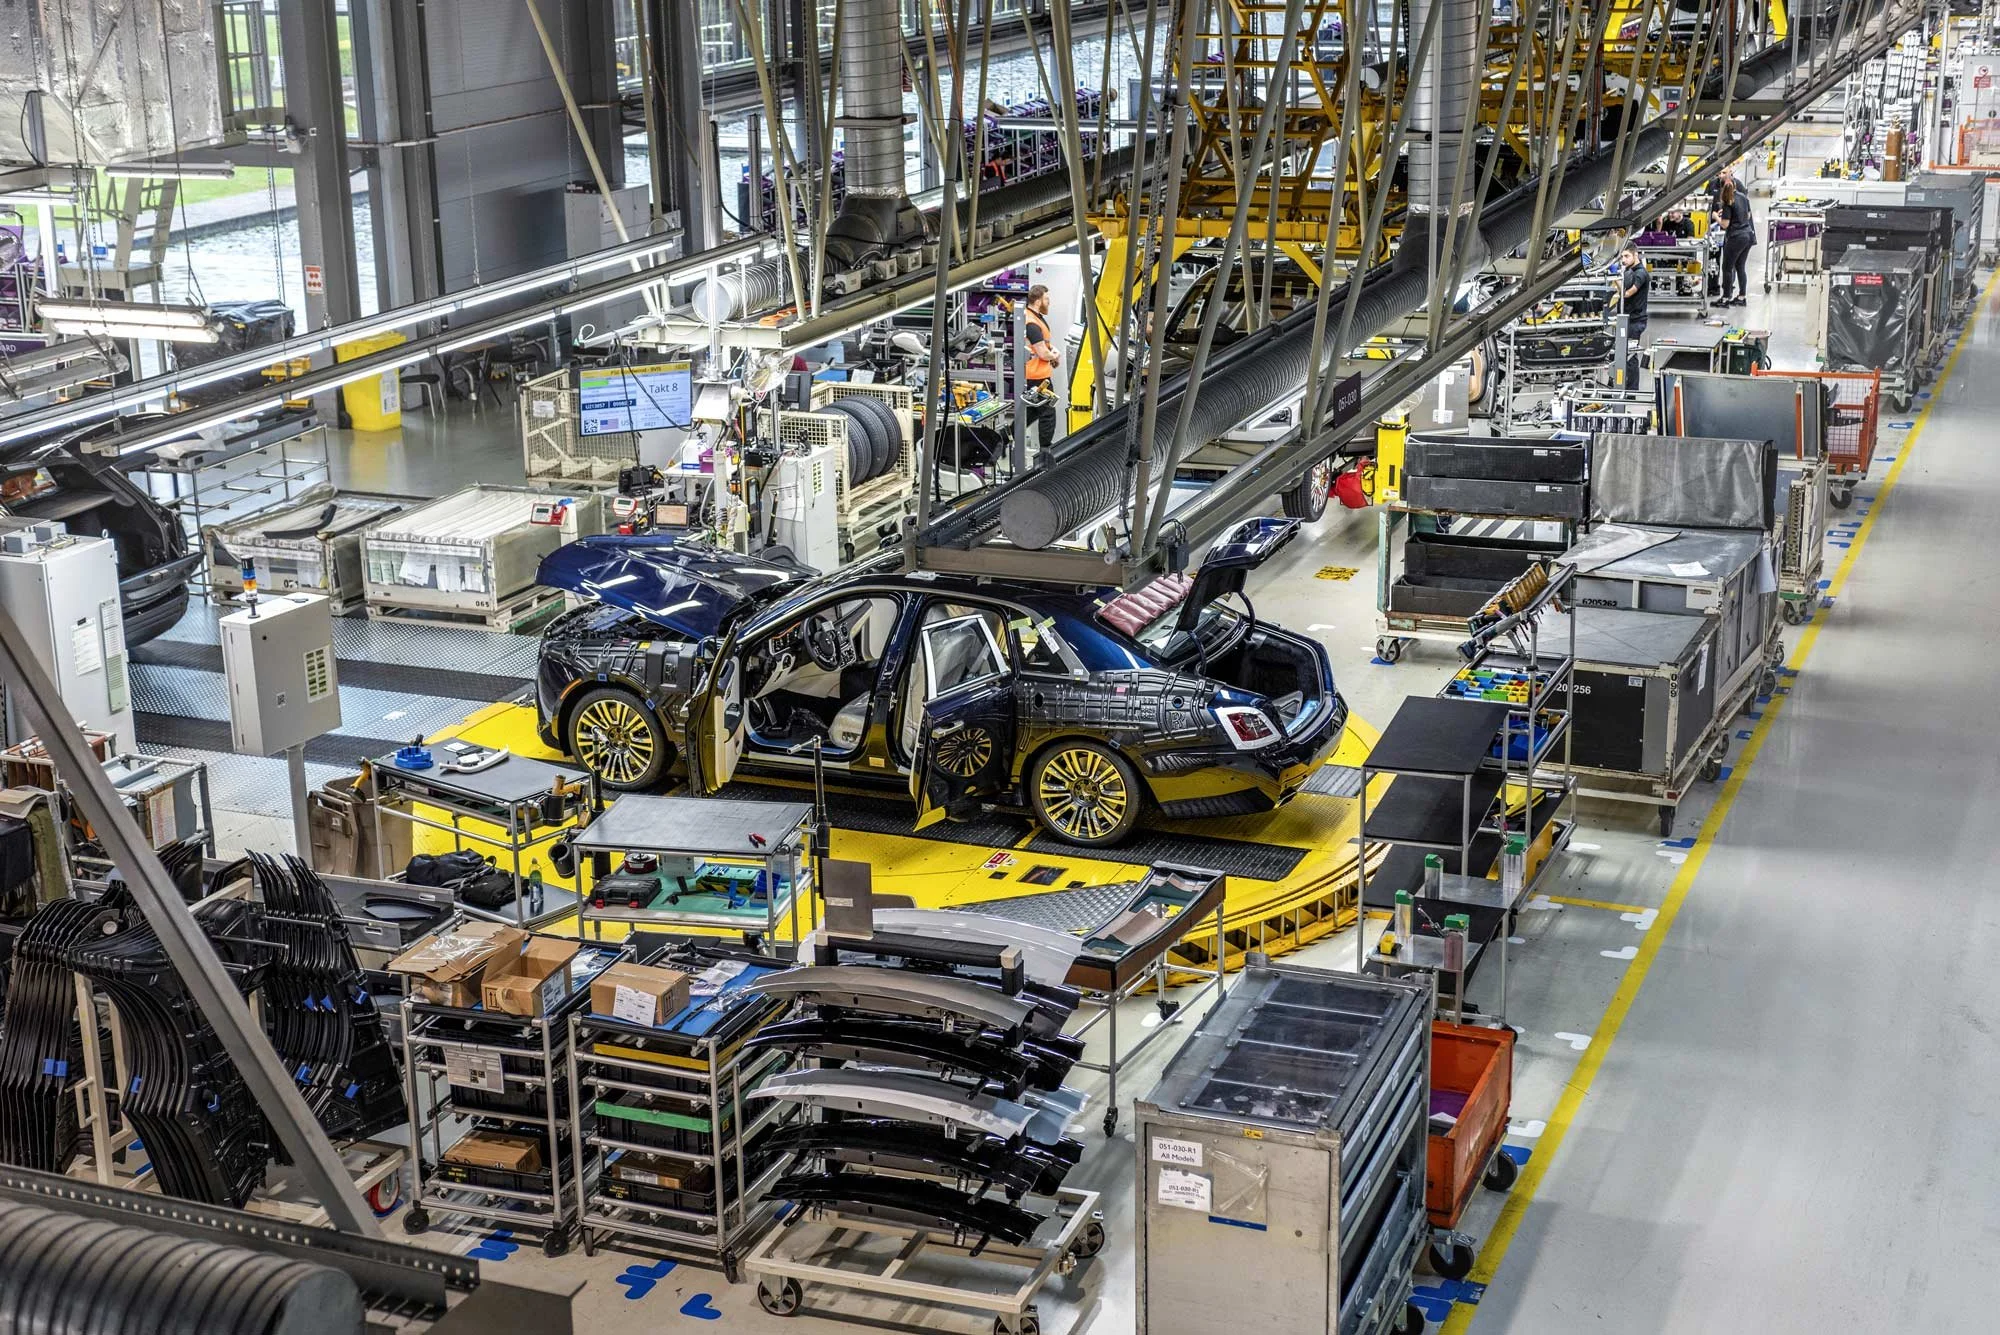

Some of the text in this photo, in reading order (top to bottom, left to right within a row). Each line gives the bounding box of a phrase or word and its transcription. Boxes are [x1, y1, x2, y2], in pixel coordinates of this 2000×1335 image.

[649, 383, 679, 394] Takt 8
[1338, 389, 1358, 412] 051-030
[1556, 683, 1592, 695] 20256
[1670, 673, 1678, 698] 099
[1158, 1143, 1196, 1154] 051-030-R1
[1171, 1154, 1195, 1163] Models
